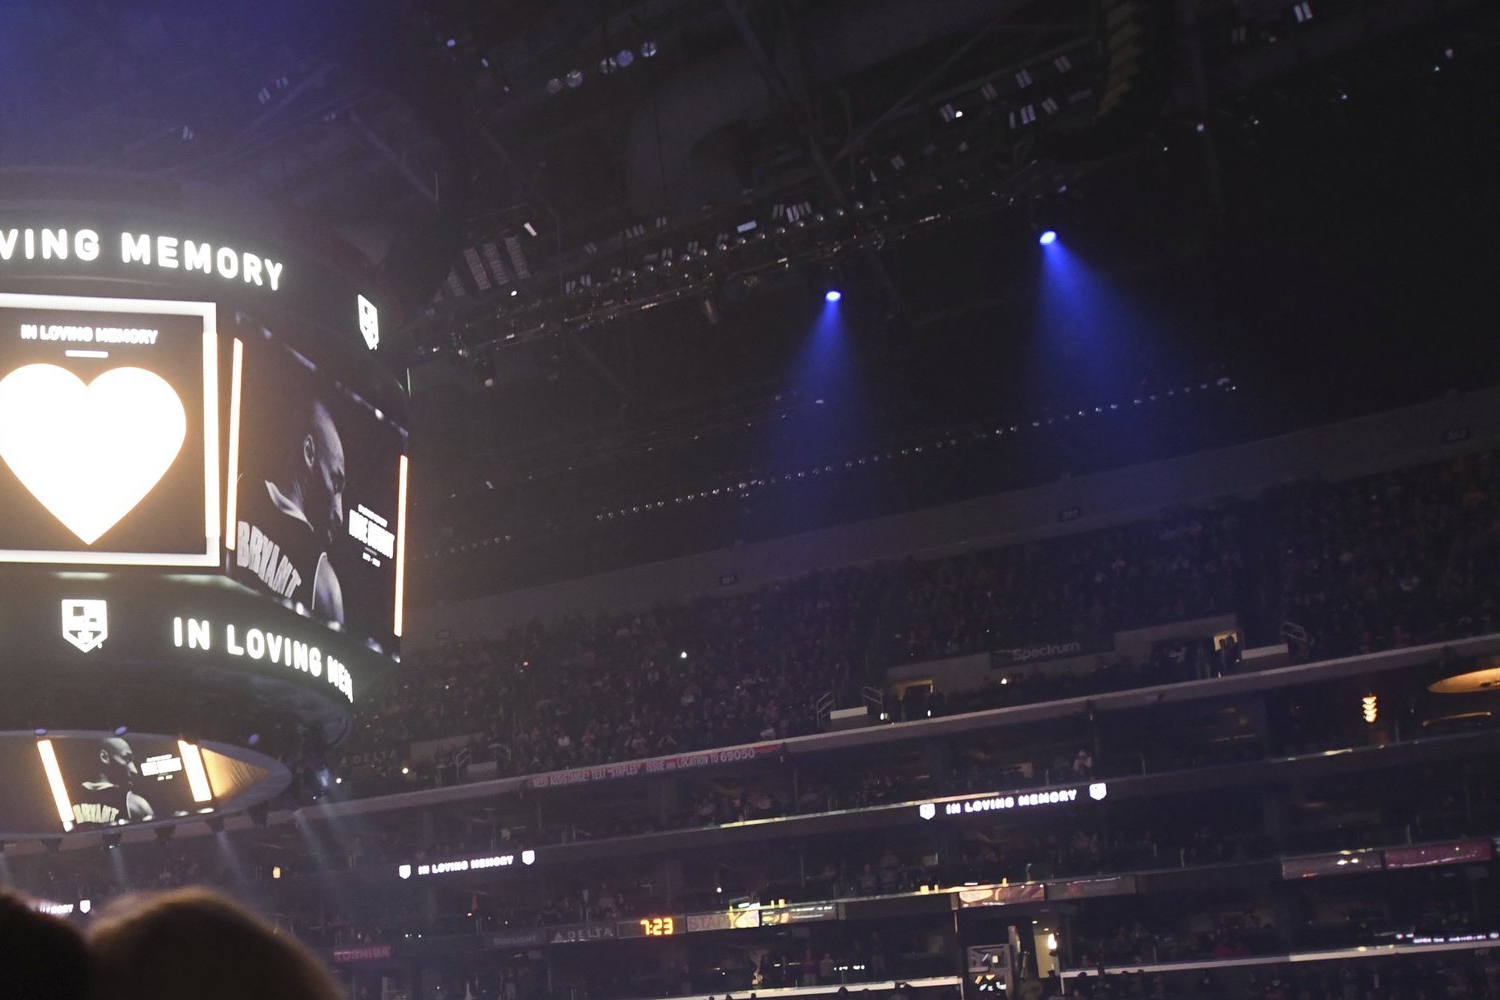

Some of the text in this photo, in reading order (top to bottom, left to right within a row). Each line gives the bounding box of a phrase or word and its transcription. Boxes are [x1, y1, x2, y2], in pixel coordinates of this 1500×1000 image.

[122, 232, 283, 292] MEMORY
[21, 325, 159, 345] IN LOVING MEMORY
[237, 521, 301, 598] BRYANT
[173, 616, 210, 650] IN
[227, 624, 322, 677] LOVING
[1012, 641, 1081, 662] Spectrum
[720, 749, 755, 763] 69050
[946, 789, 1078, 815] IN LOVING MEMORY
[418, 855, 514, 875] IN LOVING MEMORY
[566, 922, 614, 941] DELTA
[640, 916, 674, 936] 7:23
[334, 944, 391, 961] TOSHIBA
